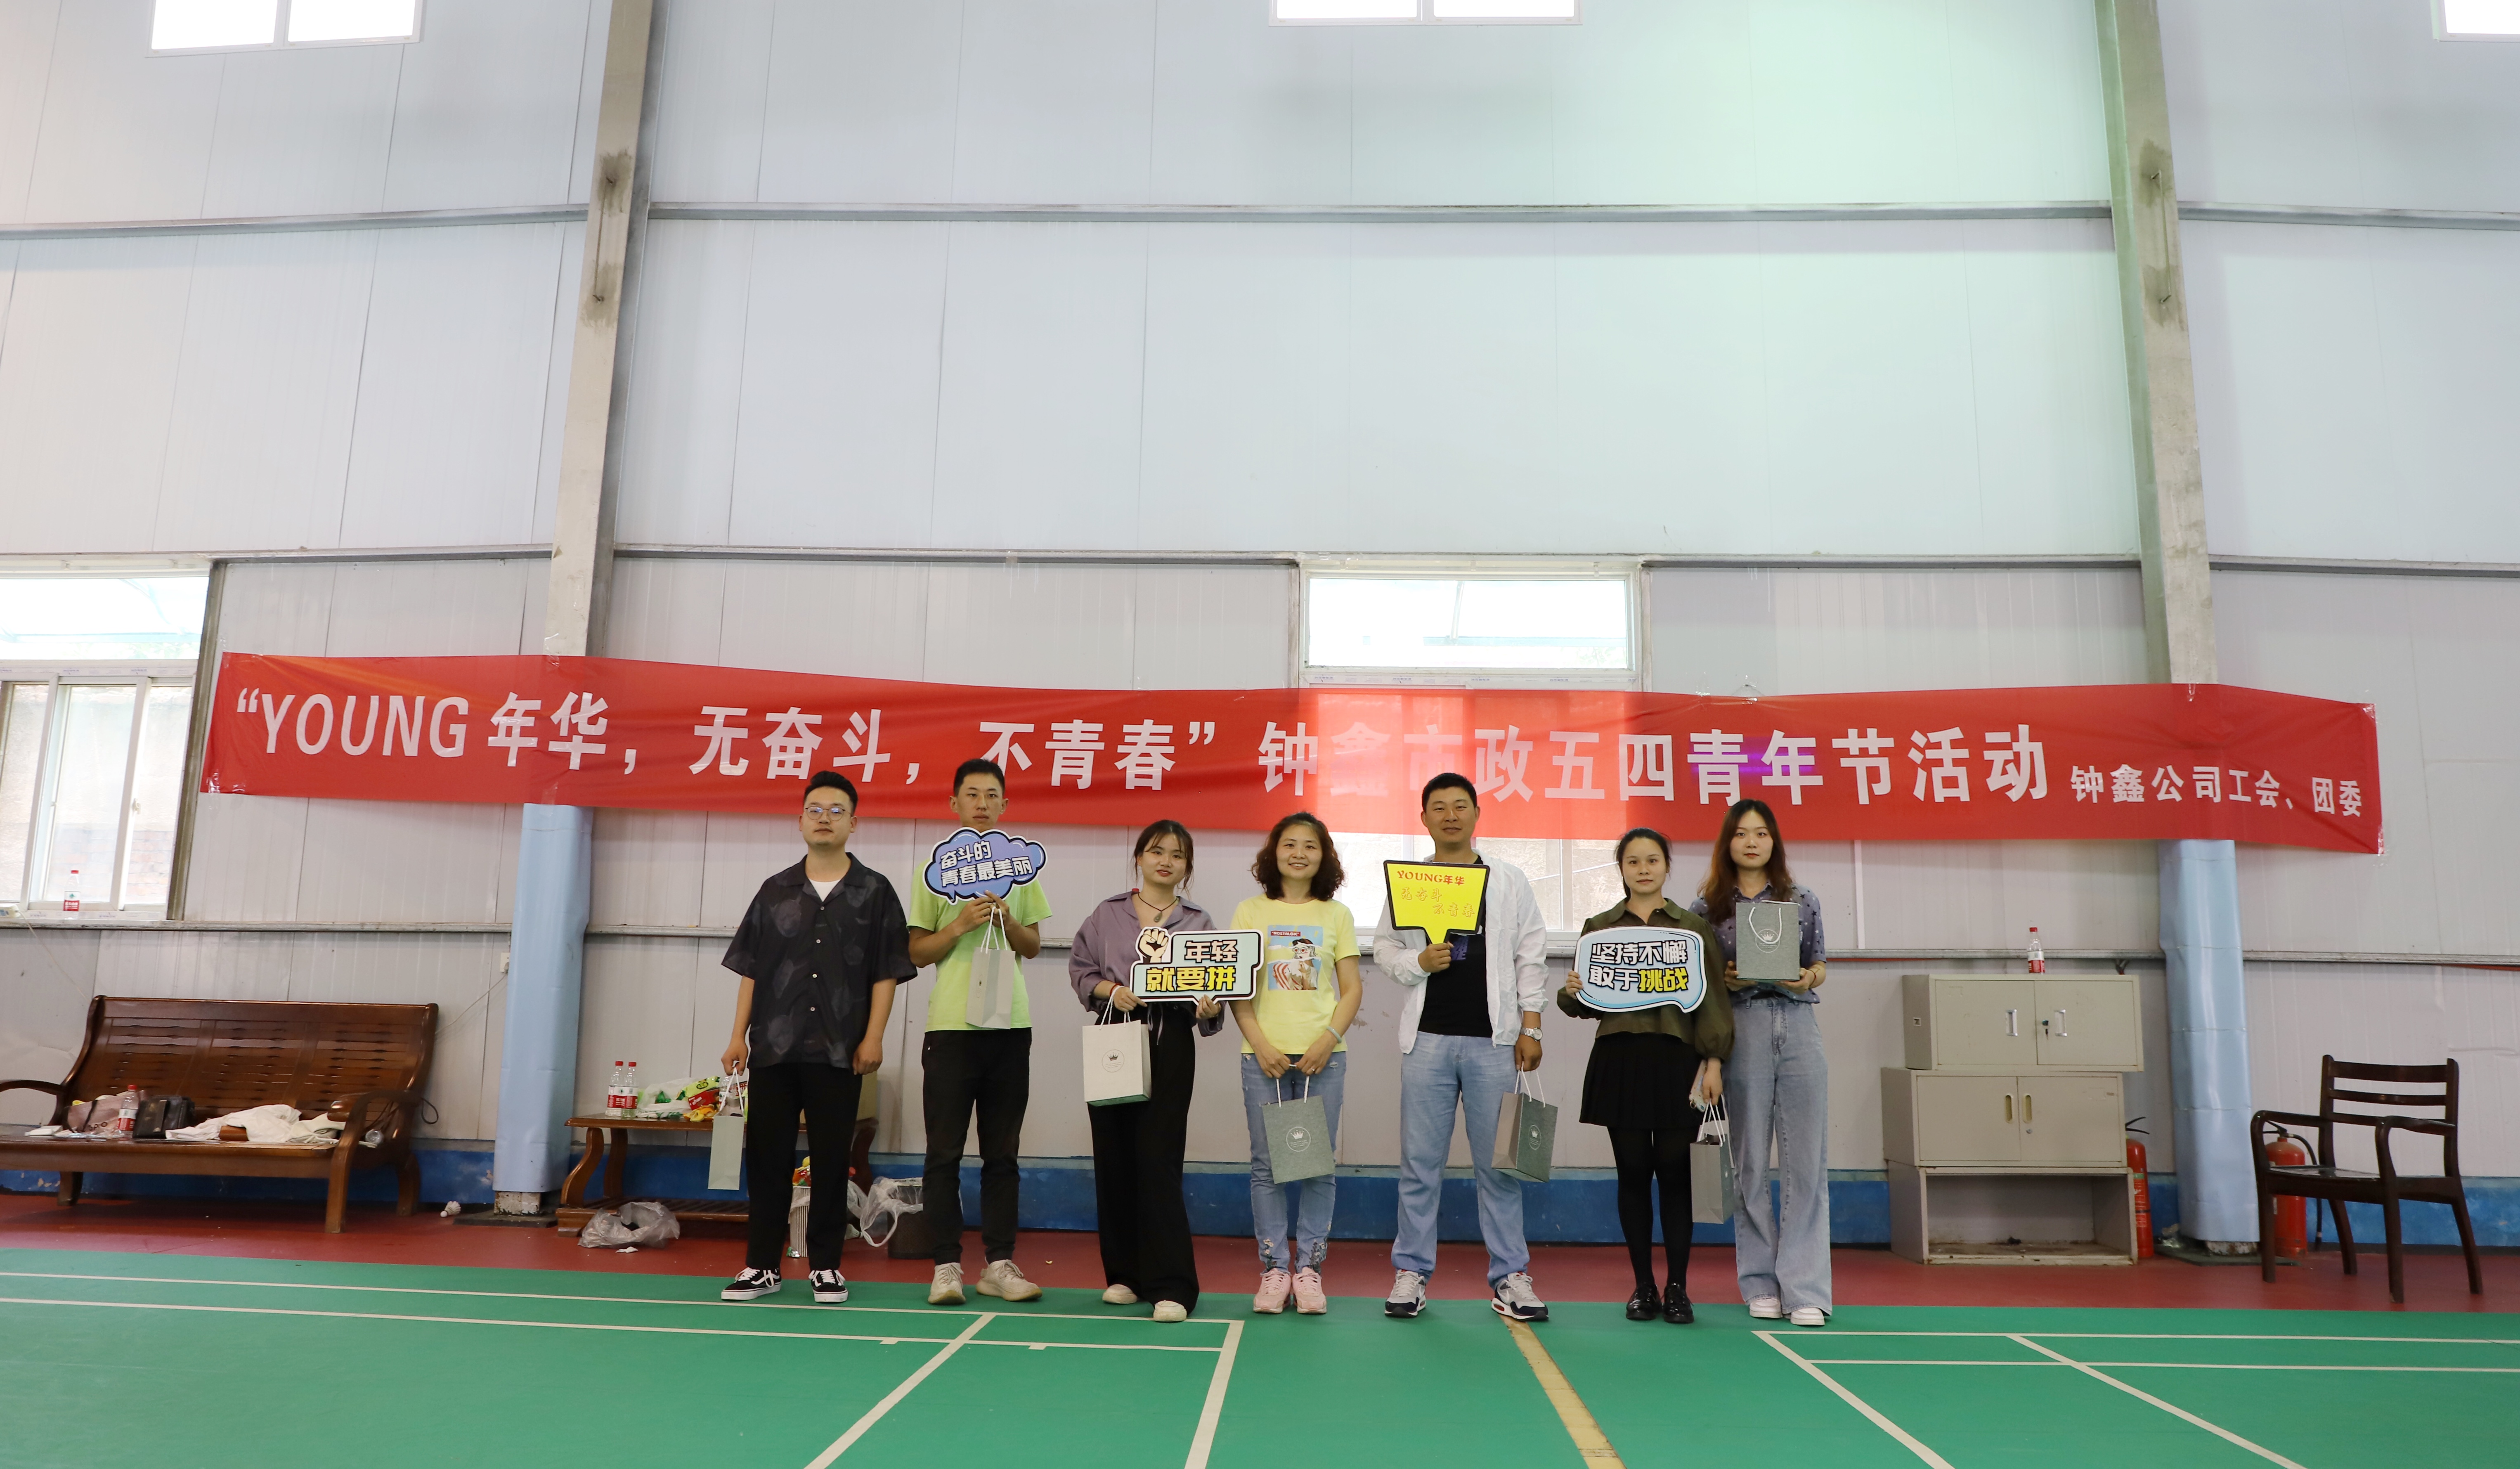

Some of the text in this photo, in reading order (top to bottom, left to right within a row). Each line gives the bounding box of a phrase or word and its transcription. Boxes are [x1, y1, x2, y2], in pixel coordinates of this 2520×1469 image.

[940, 840, 992, 870] 奋斗的
[941, 856, 1033, 887] 青春最美丽
[1401, 887, 1442, 902] 无奋斗
[1432, 902, 1475, 918] 不青春
[1184, 939, 1238, 963] 年轻
[1590, 940, 1688, 965] 坚持不懈
[1146, 965, 1236, 992] 就要拼
[1588, 964, 1689, 993] 敢于挑战
